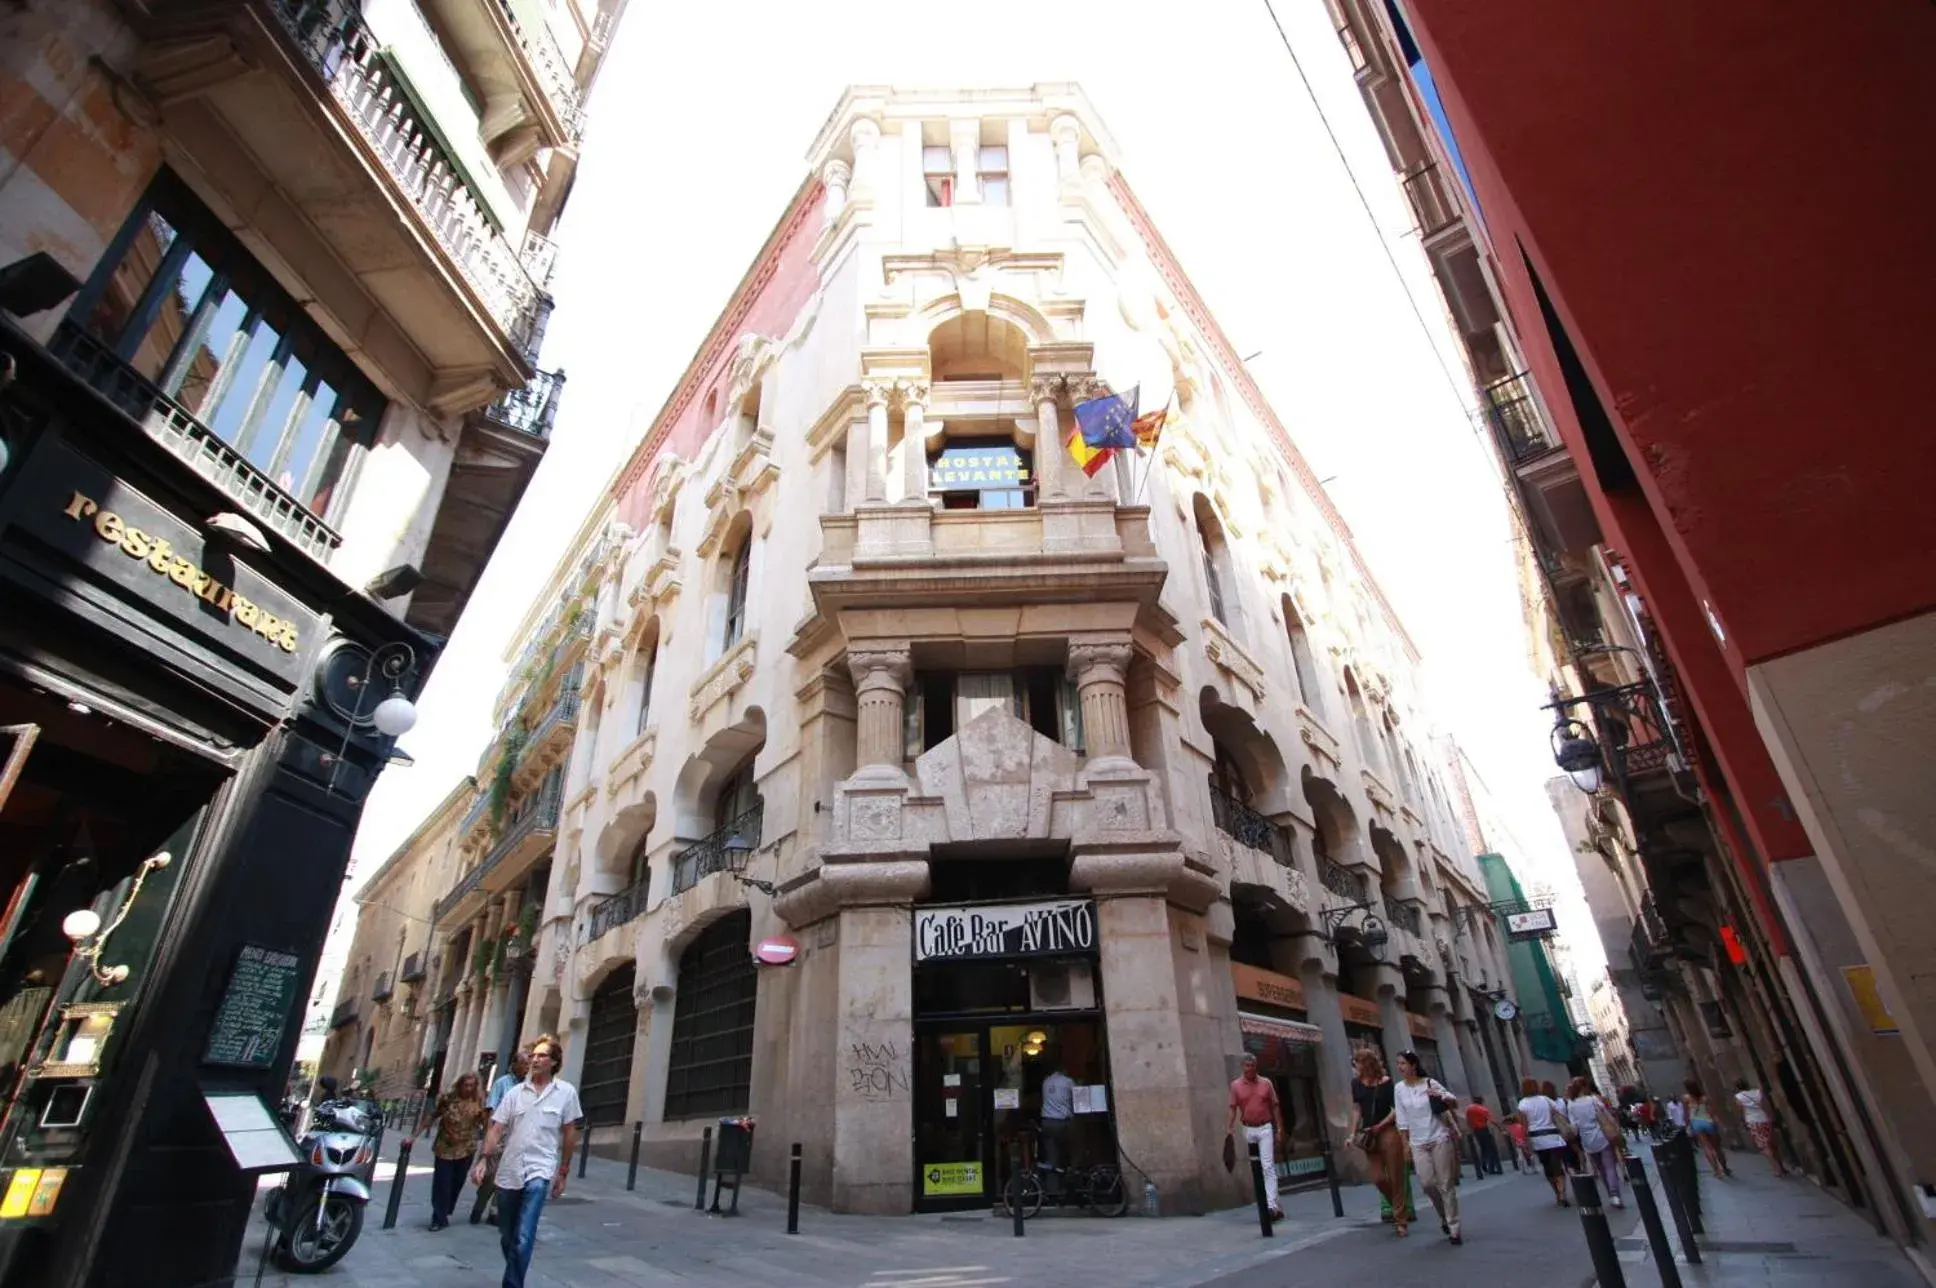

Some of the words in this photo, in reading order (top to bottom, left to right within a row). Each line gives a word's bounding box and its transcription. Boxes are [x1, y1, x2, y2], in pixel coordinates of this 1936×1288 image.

[932, 469, 1029, 482] LEVANTE
[938, 456, 1023, 468] HOSTAL
[64, 489, 298, 653] restaurant
[920, 912, 965, 957] Café
[971, 914, 1008, 954] Bar
